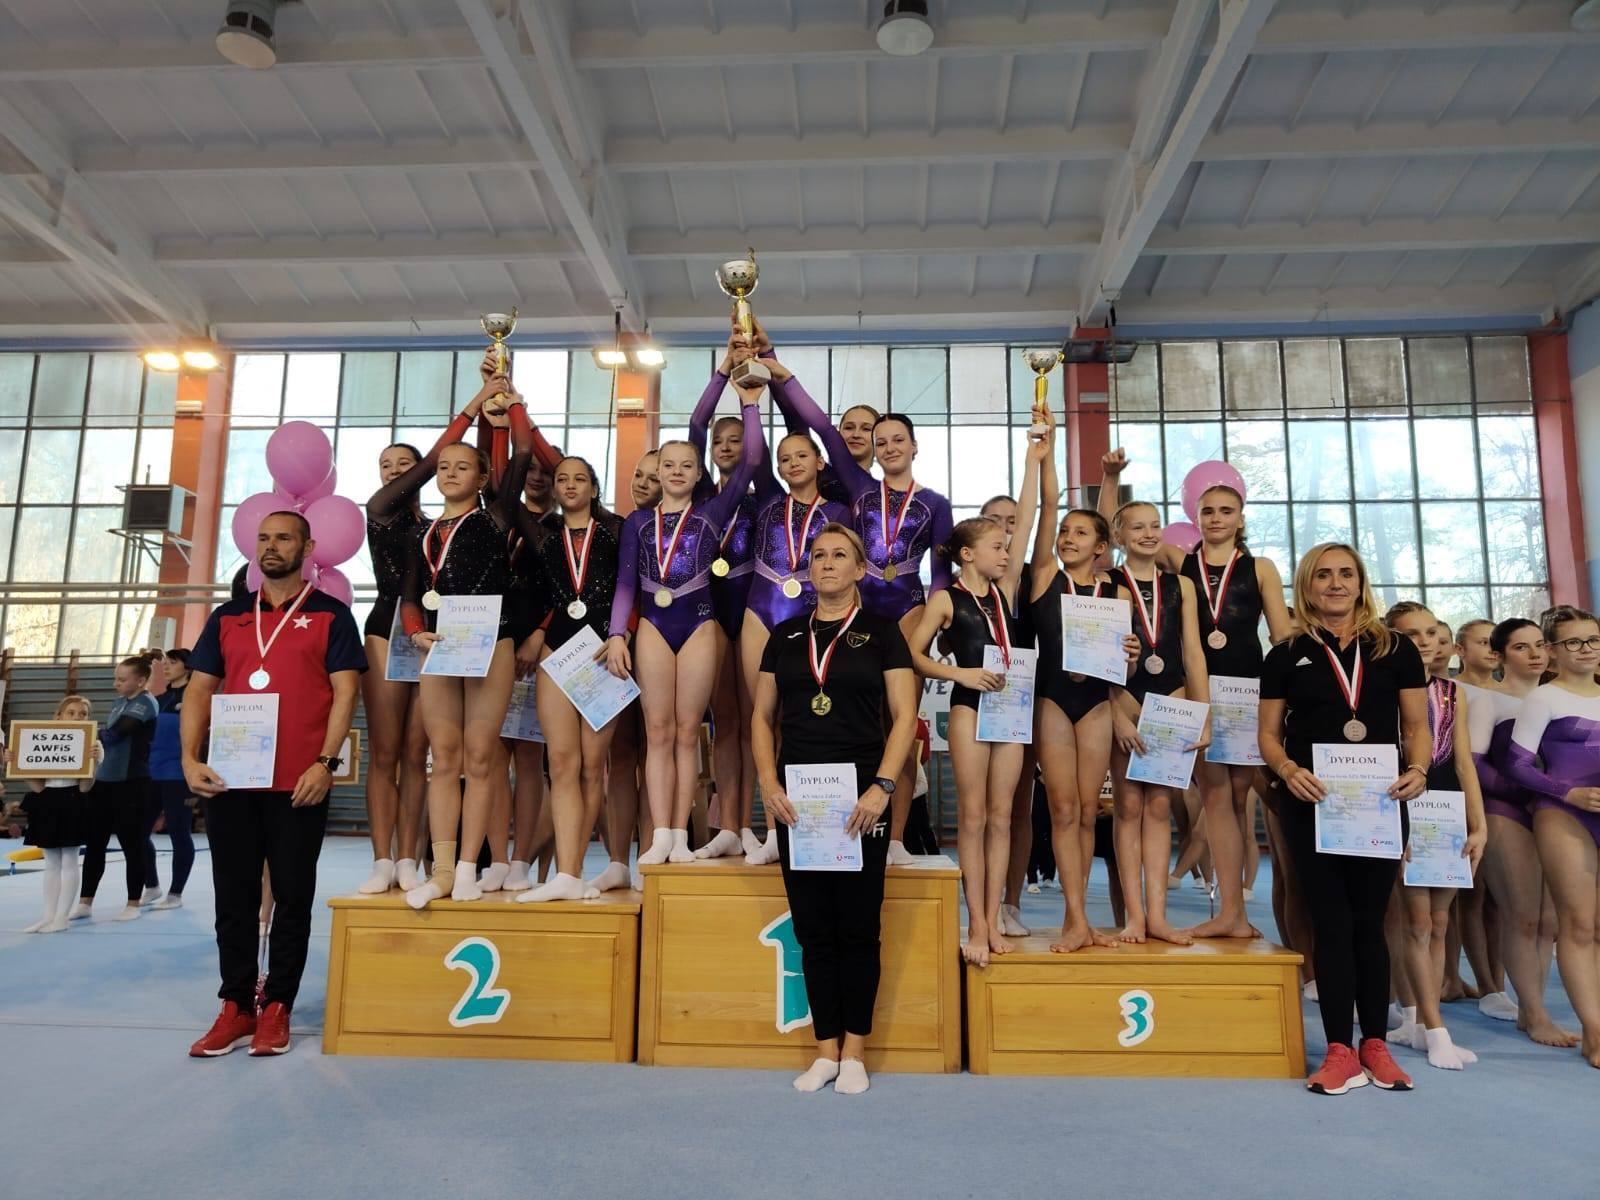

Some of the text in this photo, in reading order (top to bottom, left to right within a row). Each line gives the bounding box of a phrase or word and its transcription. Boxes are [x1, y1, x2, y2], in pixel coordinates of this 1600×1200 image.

[451, 605, 487, 613] DYPLOM
[1076, 602, 1115, 612] DYPLOM
[557, 641, 588, 668] DYPLOM
[1222, 685, 1259, 695] DYPLOM
[225, 703, 264, 712] DYPLOM
[1156, 704, 1193, 717] DYPLOM
[32, 733, 74, 741] KS AZS
[33, 744, 71, 752] AWFiS
[26, 752, 76, 763] GDAŃSK
[1330, 756, 1377, 764] DYPLOM
[800, 776, 841, 785] DYPLOM
[1414, 801, 1450, 809] DYPLOM
[445, 937, 510, 1027] 2
[1118, 989, 1154, 1047] 3
